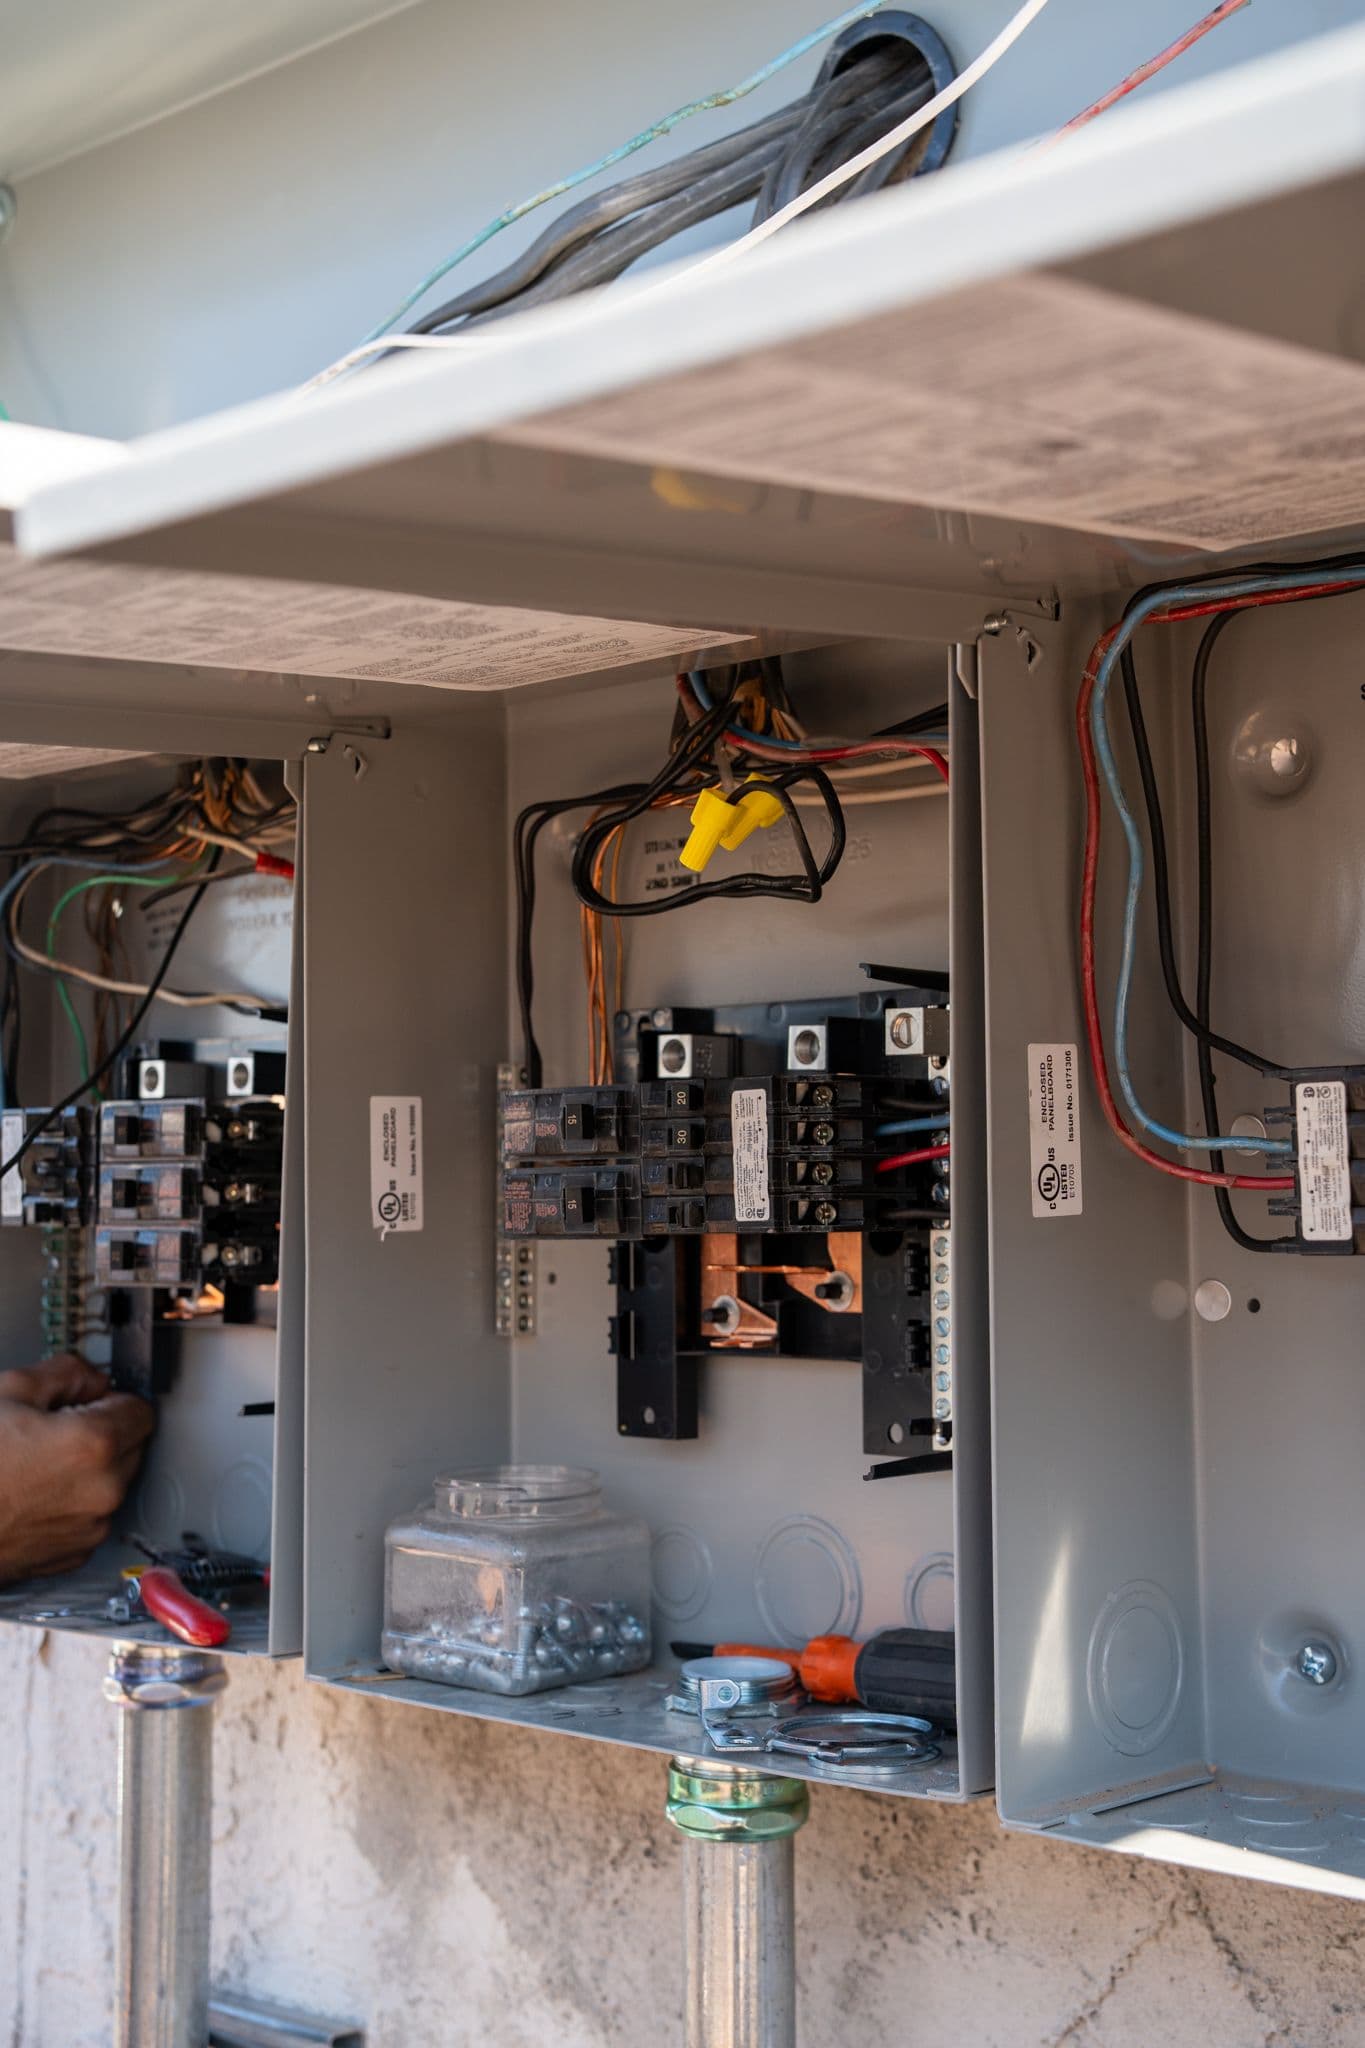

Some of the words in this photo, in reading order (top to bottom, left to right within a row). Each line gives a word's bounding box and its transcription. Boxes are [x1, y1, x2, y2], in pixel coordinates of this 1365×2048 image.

[677, 1091, 686, 1105] 20
[1046, 1054, 1055, 1131] PANELBOARD
[1066, 1092, 1074, 1110] No.
[567, 1114, 577, 1125] 15
[677, 1129, 687, 1144] 30
[1048, 1147, 1055, 1161] US
[1043, 1172, 1056, 1192] UL
[384, 1200, 396, 1215] UL
[567, 1199, 577, 1210] 15
